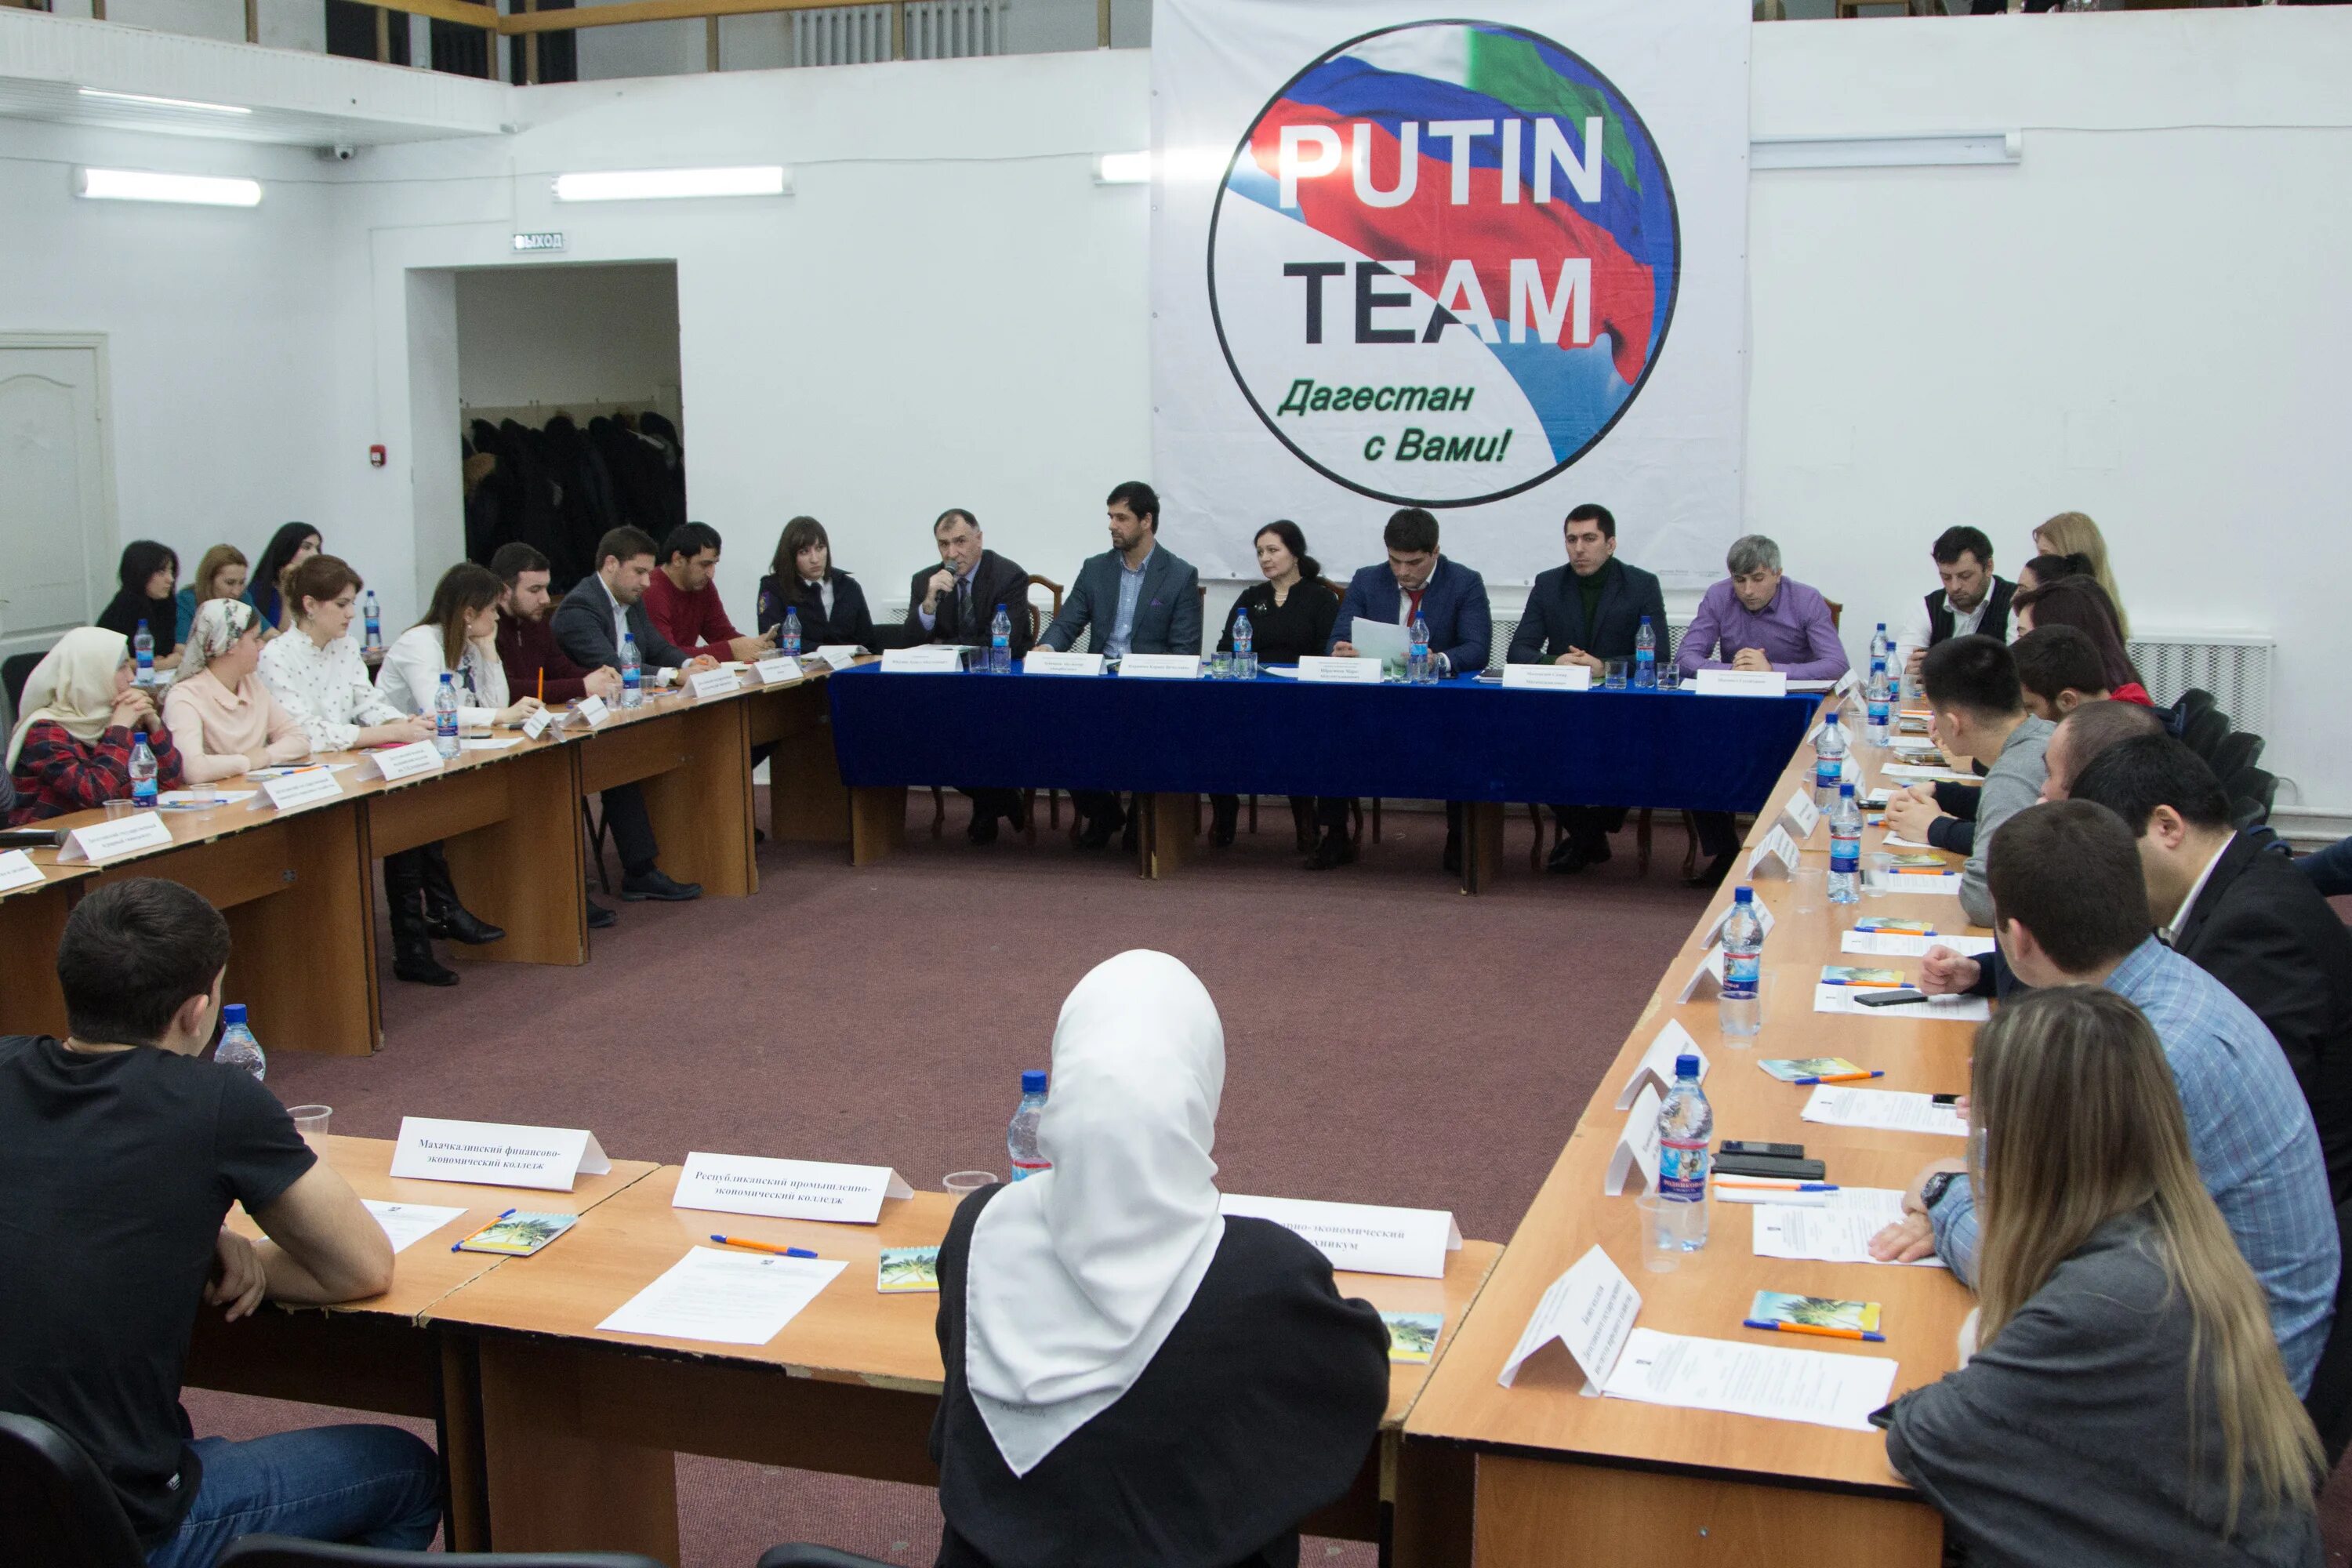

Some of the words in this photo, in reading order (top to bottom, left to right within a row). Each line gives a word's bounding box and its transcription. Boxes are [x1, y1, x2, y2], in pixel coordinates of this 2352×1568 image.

[1279, 116, 1603, 209] PUTIN
[1283, 258, 1592, 344] TEAM
[1277, 379, 1475, 416] Дагестан
[1363, 436, 1386, 462] с
[1395, 427, 1514, 462] Вами!
[418, 1138, 503, 1154] Махачкалинский
[505, 1146, 561, 1157] финансово-
[426, 1155, 500, 1168] экономический
[503, 1161, 544, 1171] колледж
[695, 1171, 788, 1187] Республиканский
[790, 1180, 872, 1192] промышленно-
[714, 1187, 795, 1201] экономический
[797, 1195, 844, 1205] колледж
